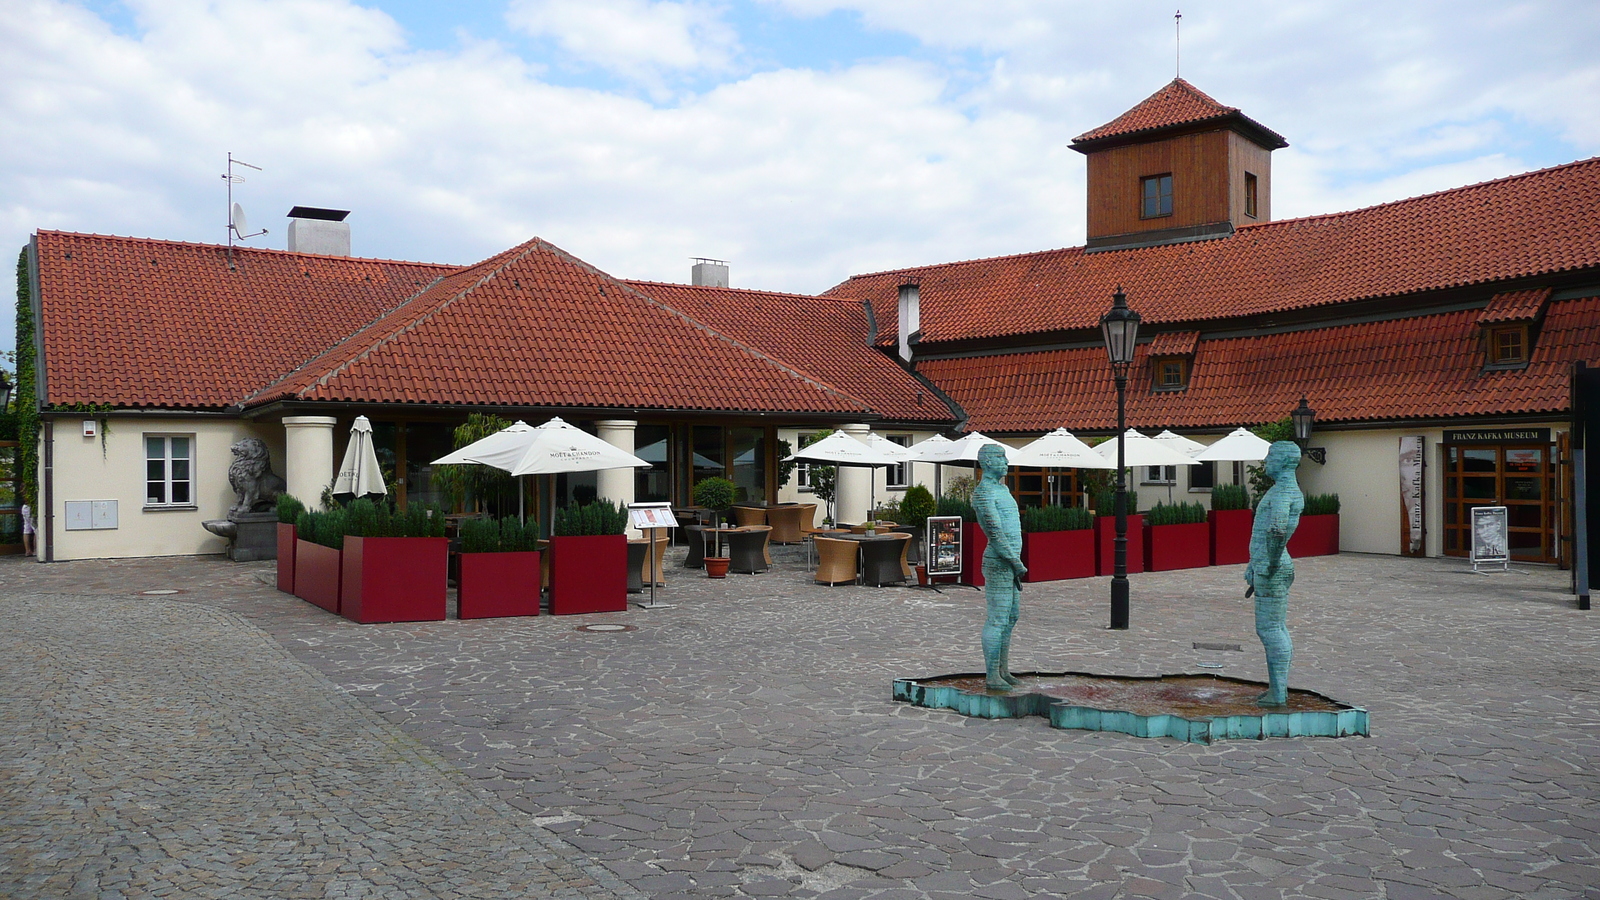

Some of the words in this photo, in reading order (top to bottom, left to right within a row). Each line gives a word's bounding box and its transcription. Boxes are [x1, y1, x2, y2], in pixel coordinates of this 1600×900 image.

[1477, 432, 1502, 440] KAFKA
[1503, 431, 1538, 439] MUSEUM
[1412, 471, 1420, 499] Kafka
[1412, 502, 1420, 529] Franz
